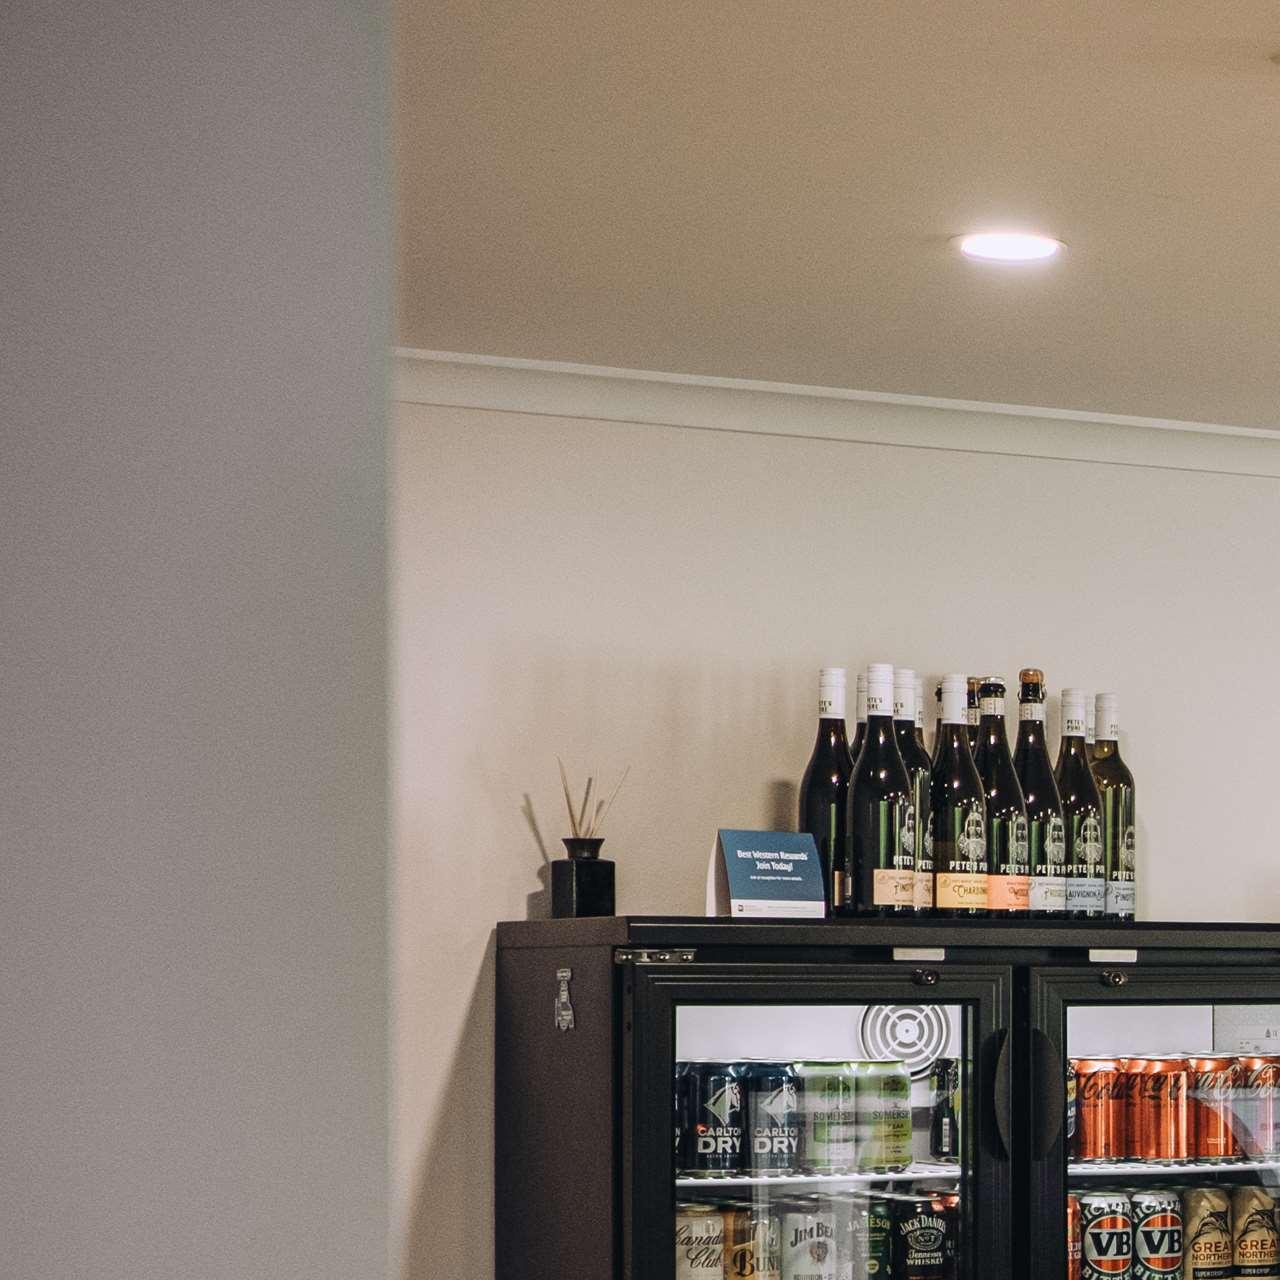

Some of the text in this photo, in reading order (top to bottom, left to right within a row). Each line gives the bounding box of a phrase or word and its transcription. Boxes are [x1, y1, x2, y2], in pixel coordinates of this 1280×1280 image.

[737, 850, 752, 859] Best
[752, 851, 779, 859] Western
[756, 861, 794, 873] Join Today!
[697, 1137, 741, 1154] DRY
[753, 1137, 800, 1154] DRY
[900, 1216, 920, 1236] JACK
[790, 1225, 814, 1248] JIM
[1088, 1231, 1132, 1257] VB
[1140, 1228, 1182, 1255] VB
[906, 1258, 943, 1266] WHISKEY
